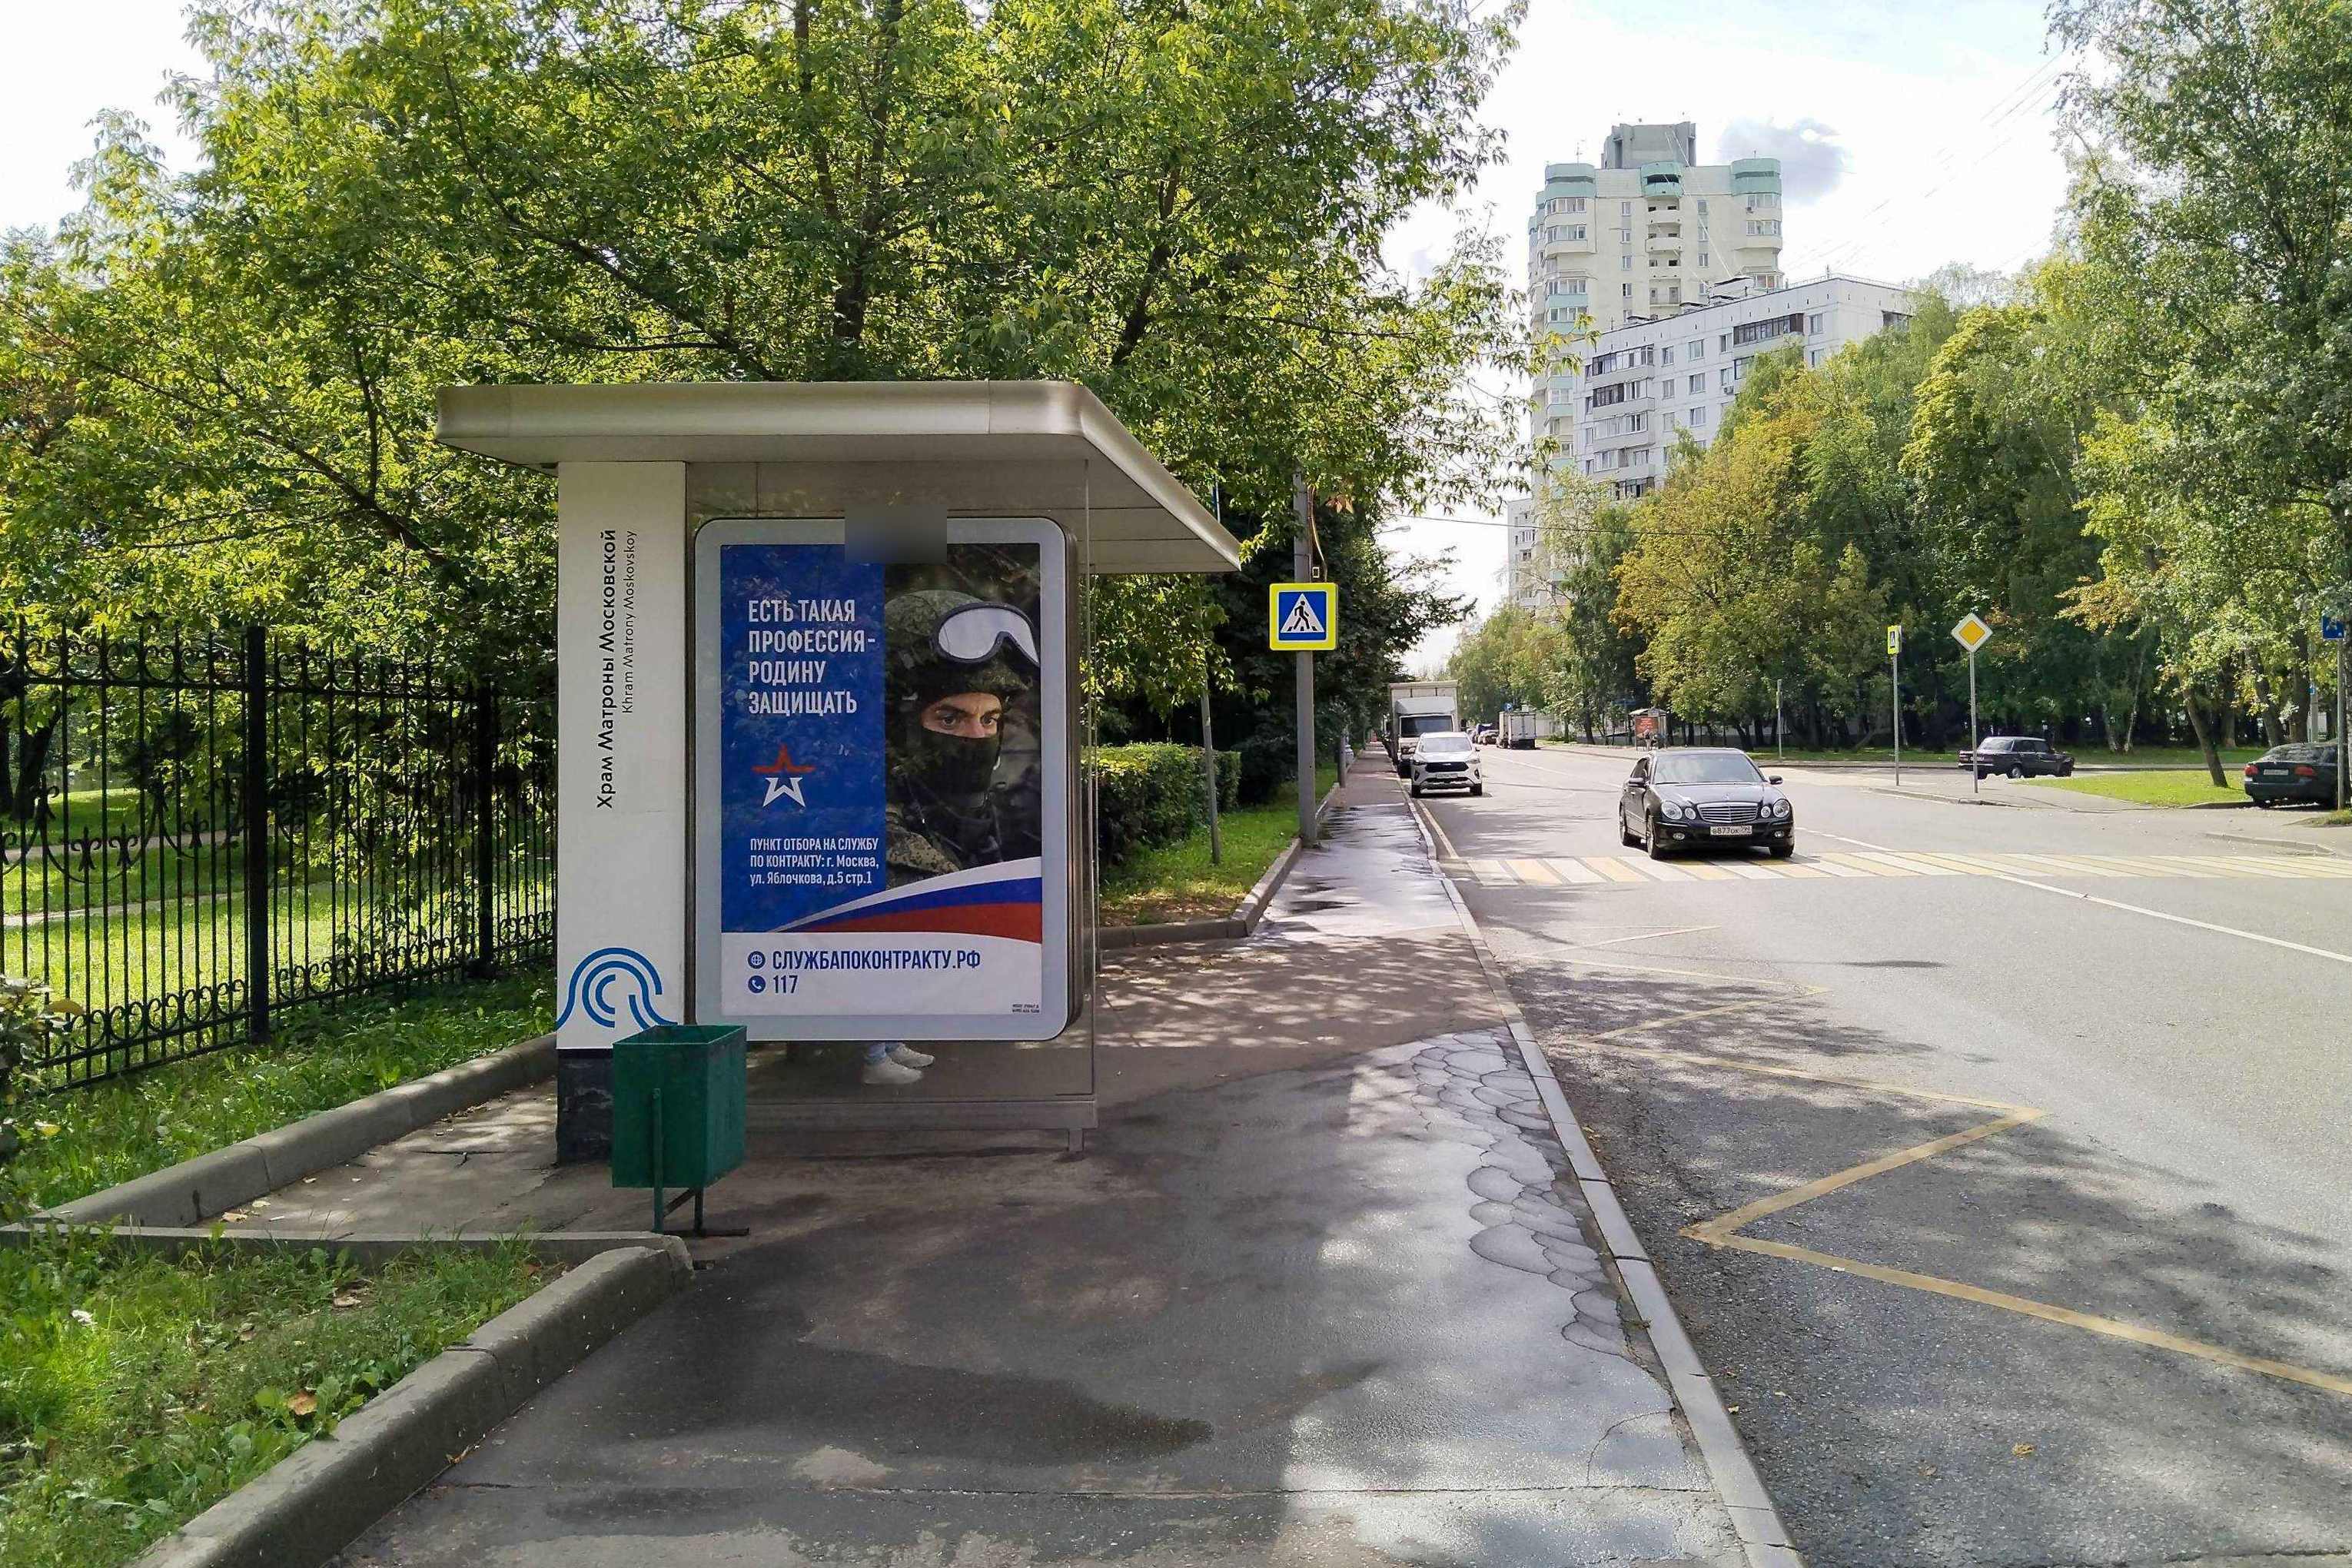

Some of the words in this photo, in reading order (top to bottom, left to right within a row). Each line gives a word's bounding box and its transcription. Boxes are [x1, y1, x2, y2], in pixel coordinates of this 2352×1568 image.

[623, 530, 637, 610] Moskovskoy
[600, 530, 616, 653] Московской
[749, 600, 794, 623] ЕСТЬ
[798, 600, 855, 622] ТАКАЯ
[623, 613, 636, 668] Matrony
[749, 661, 826, 686] РОДИНУ
[597, 657, 617, 751] Матроны
[622, 672, 633, 713] Khram
[749, 690, 858, 717] ЗАЩИЩАТЬ
[596, 756, 616, 809] Храм
[750, 838, 782, 851] ПУНКТ
[783, 838, 822, 851] ОТБОРА
[823, 838, 836, 851] НА
[838, 838, 879, 851] СЛУЖБУ
[750, 855, 764, 868] ПО
[766, 854, 825, 868] КОНТРАКТУ:
[826, 857, 834, 868] г.
[836, 854, 879, 869] Москва,
[750, 874, 765, 887] ул.
[767, 872, 826, 885] Яблочкова,
[845, 871, 872, 886] стр.1
[772, 950, 981, 970] СЛУЖБАПОКОНТРАКТУ.РФ
[772, 975, 798, 994] 117
